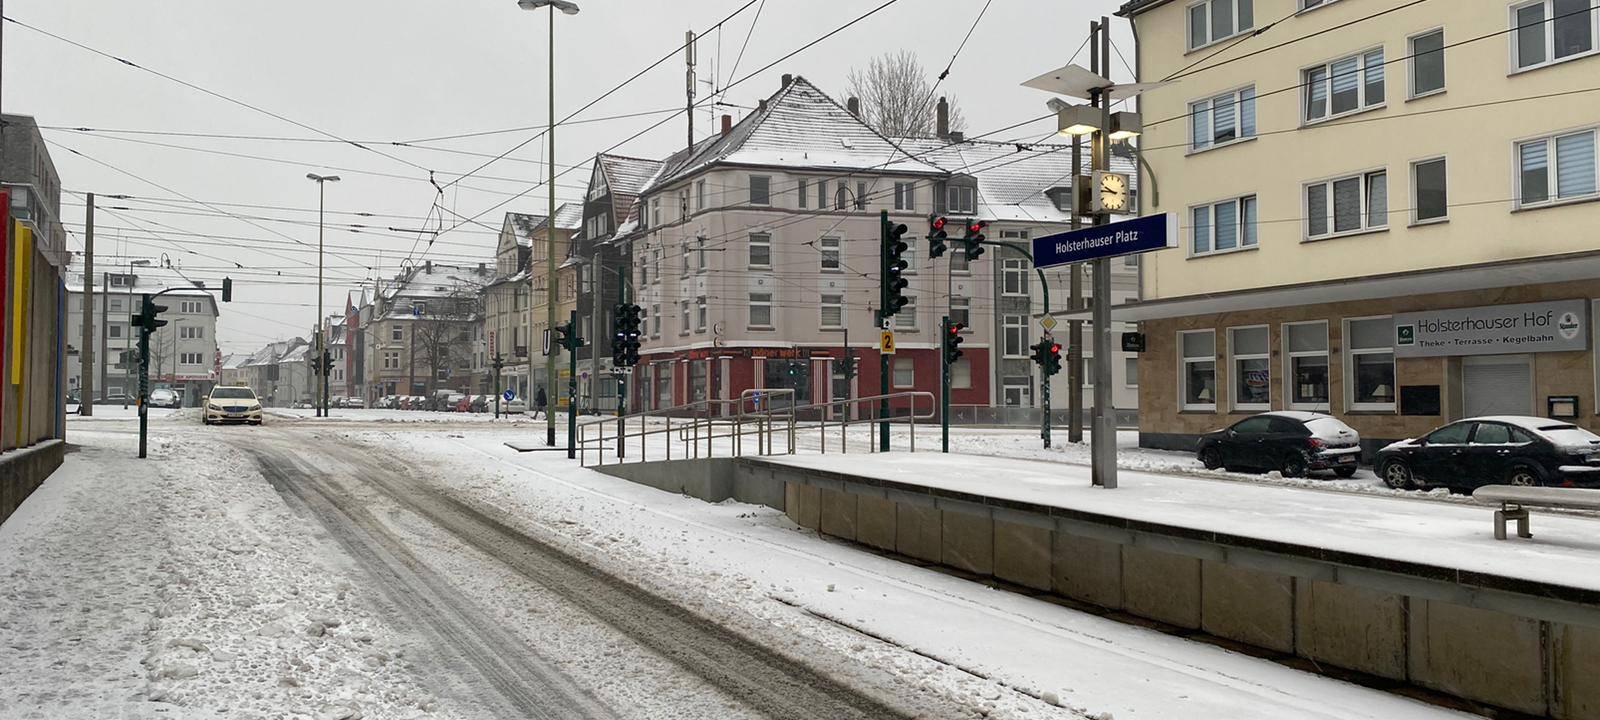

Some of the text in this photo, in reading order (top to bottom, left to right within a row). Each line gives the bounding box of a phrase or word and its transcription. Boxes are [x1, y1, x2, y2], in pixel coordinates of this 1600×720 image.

[1055, 230, 1138, 254] Holsterhauser Platz
[1418, 310, 1553, 333] Holsterhauser Hof
[543, 330, 551, 355] U
[884, 335, 891, 348] 2
[1419, 339, 1445, 348] Theke
[1454, 337, 1493, 346] Terrasse
[1502, 334, 1554, 344] Kegelbahn
